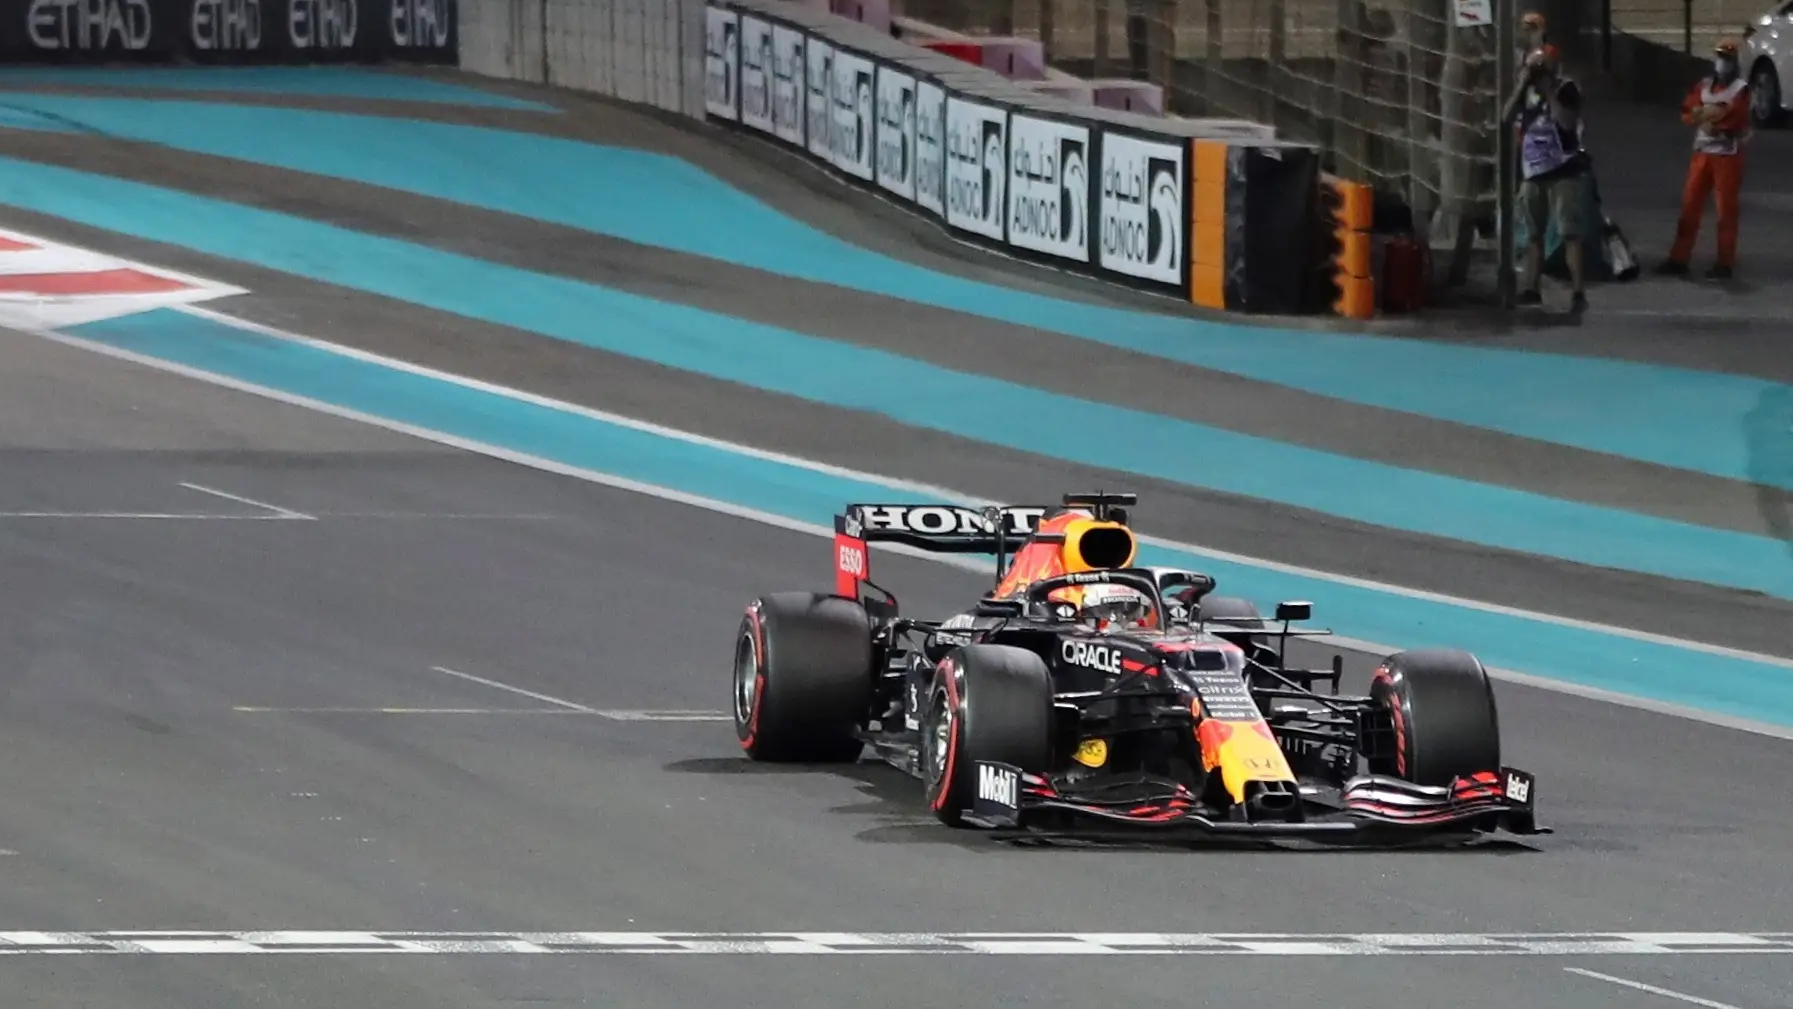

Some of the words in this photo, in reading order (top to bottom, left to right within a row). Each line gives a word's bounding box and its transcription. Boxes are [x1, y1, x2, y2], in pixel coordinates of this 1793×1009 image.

[1012, 195, 1058, 241] ADNOC
[1062, 640, 1122, 674] ORACLE
[979, 764, 1010, 806] Mobil
